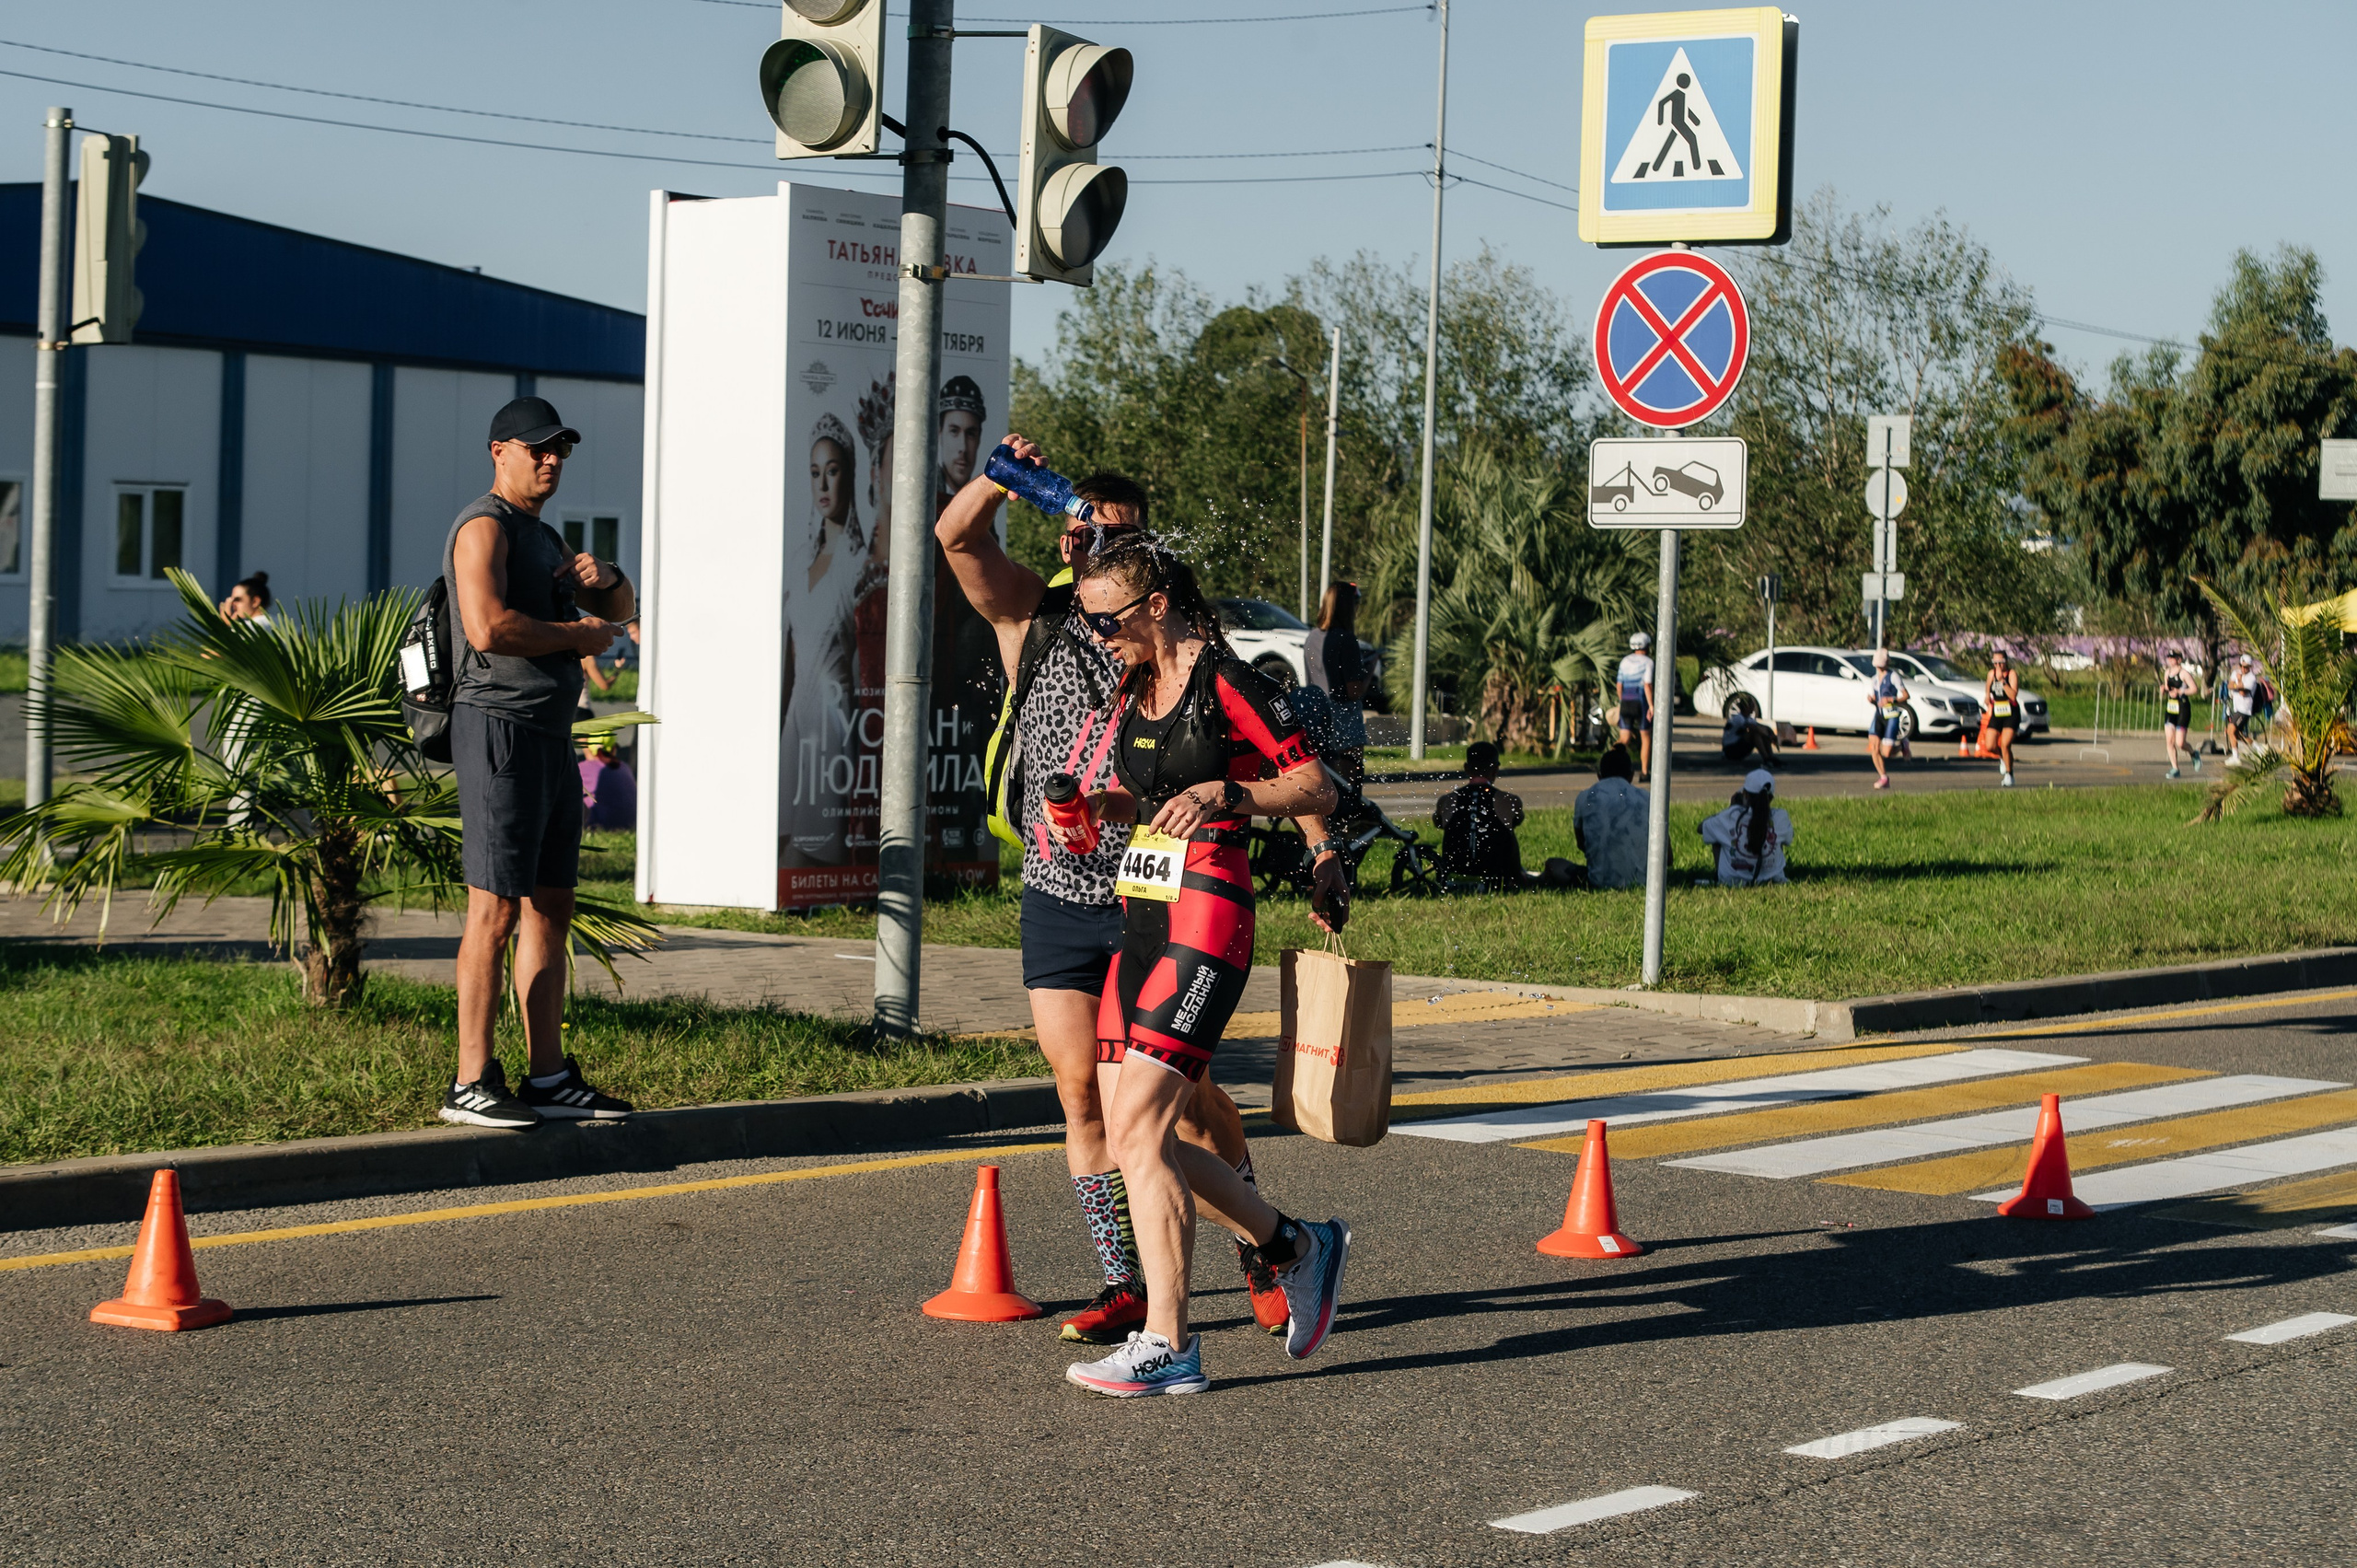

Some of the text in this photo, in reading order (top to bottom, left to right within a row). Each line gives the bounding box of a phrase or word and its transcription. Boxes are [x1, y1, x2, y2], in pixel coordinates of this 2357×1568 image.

[817, 319, 833, 339] 12
[836, 320, 887, 343] ИЮНЯ
[943, 331, 985, 354] ТЯБРЯ
[853, 687, 885, 697] МЮЗИ
[820, 679, 958, 752] РУСН
[1132, 737, 1156, 749] HOKA
[793, 738, 986, 806] ЛЮДИЛА
[821, 806, 880, 818] ОЛИМПИЙС
[1123, 852, 1171, 882] 4464
[791, 874, 839, 889] БИЛЕТЫ
[842, 874, 860, 887] НА
[1132, 885, 1147, 894] ОЛЬГА
[1170, 964, 1210, 1030] МЕДНЫЙ
[1179, 969, 1218, 1034] ВСАДНИК
[1292, 1041, 1330, 1059] МАГНИТ
[1132, 1352, 1175, 1379] HOKA
